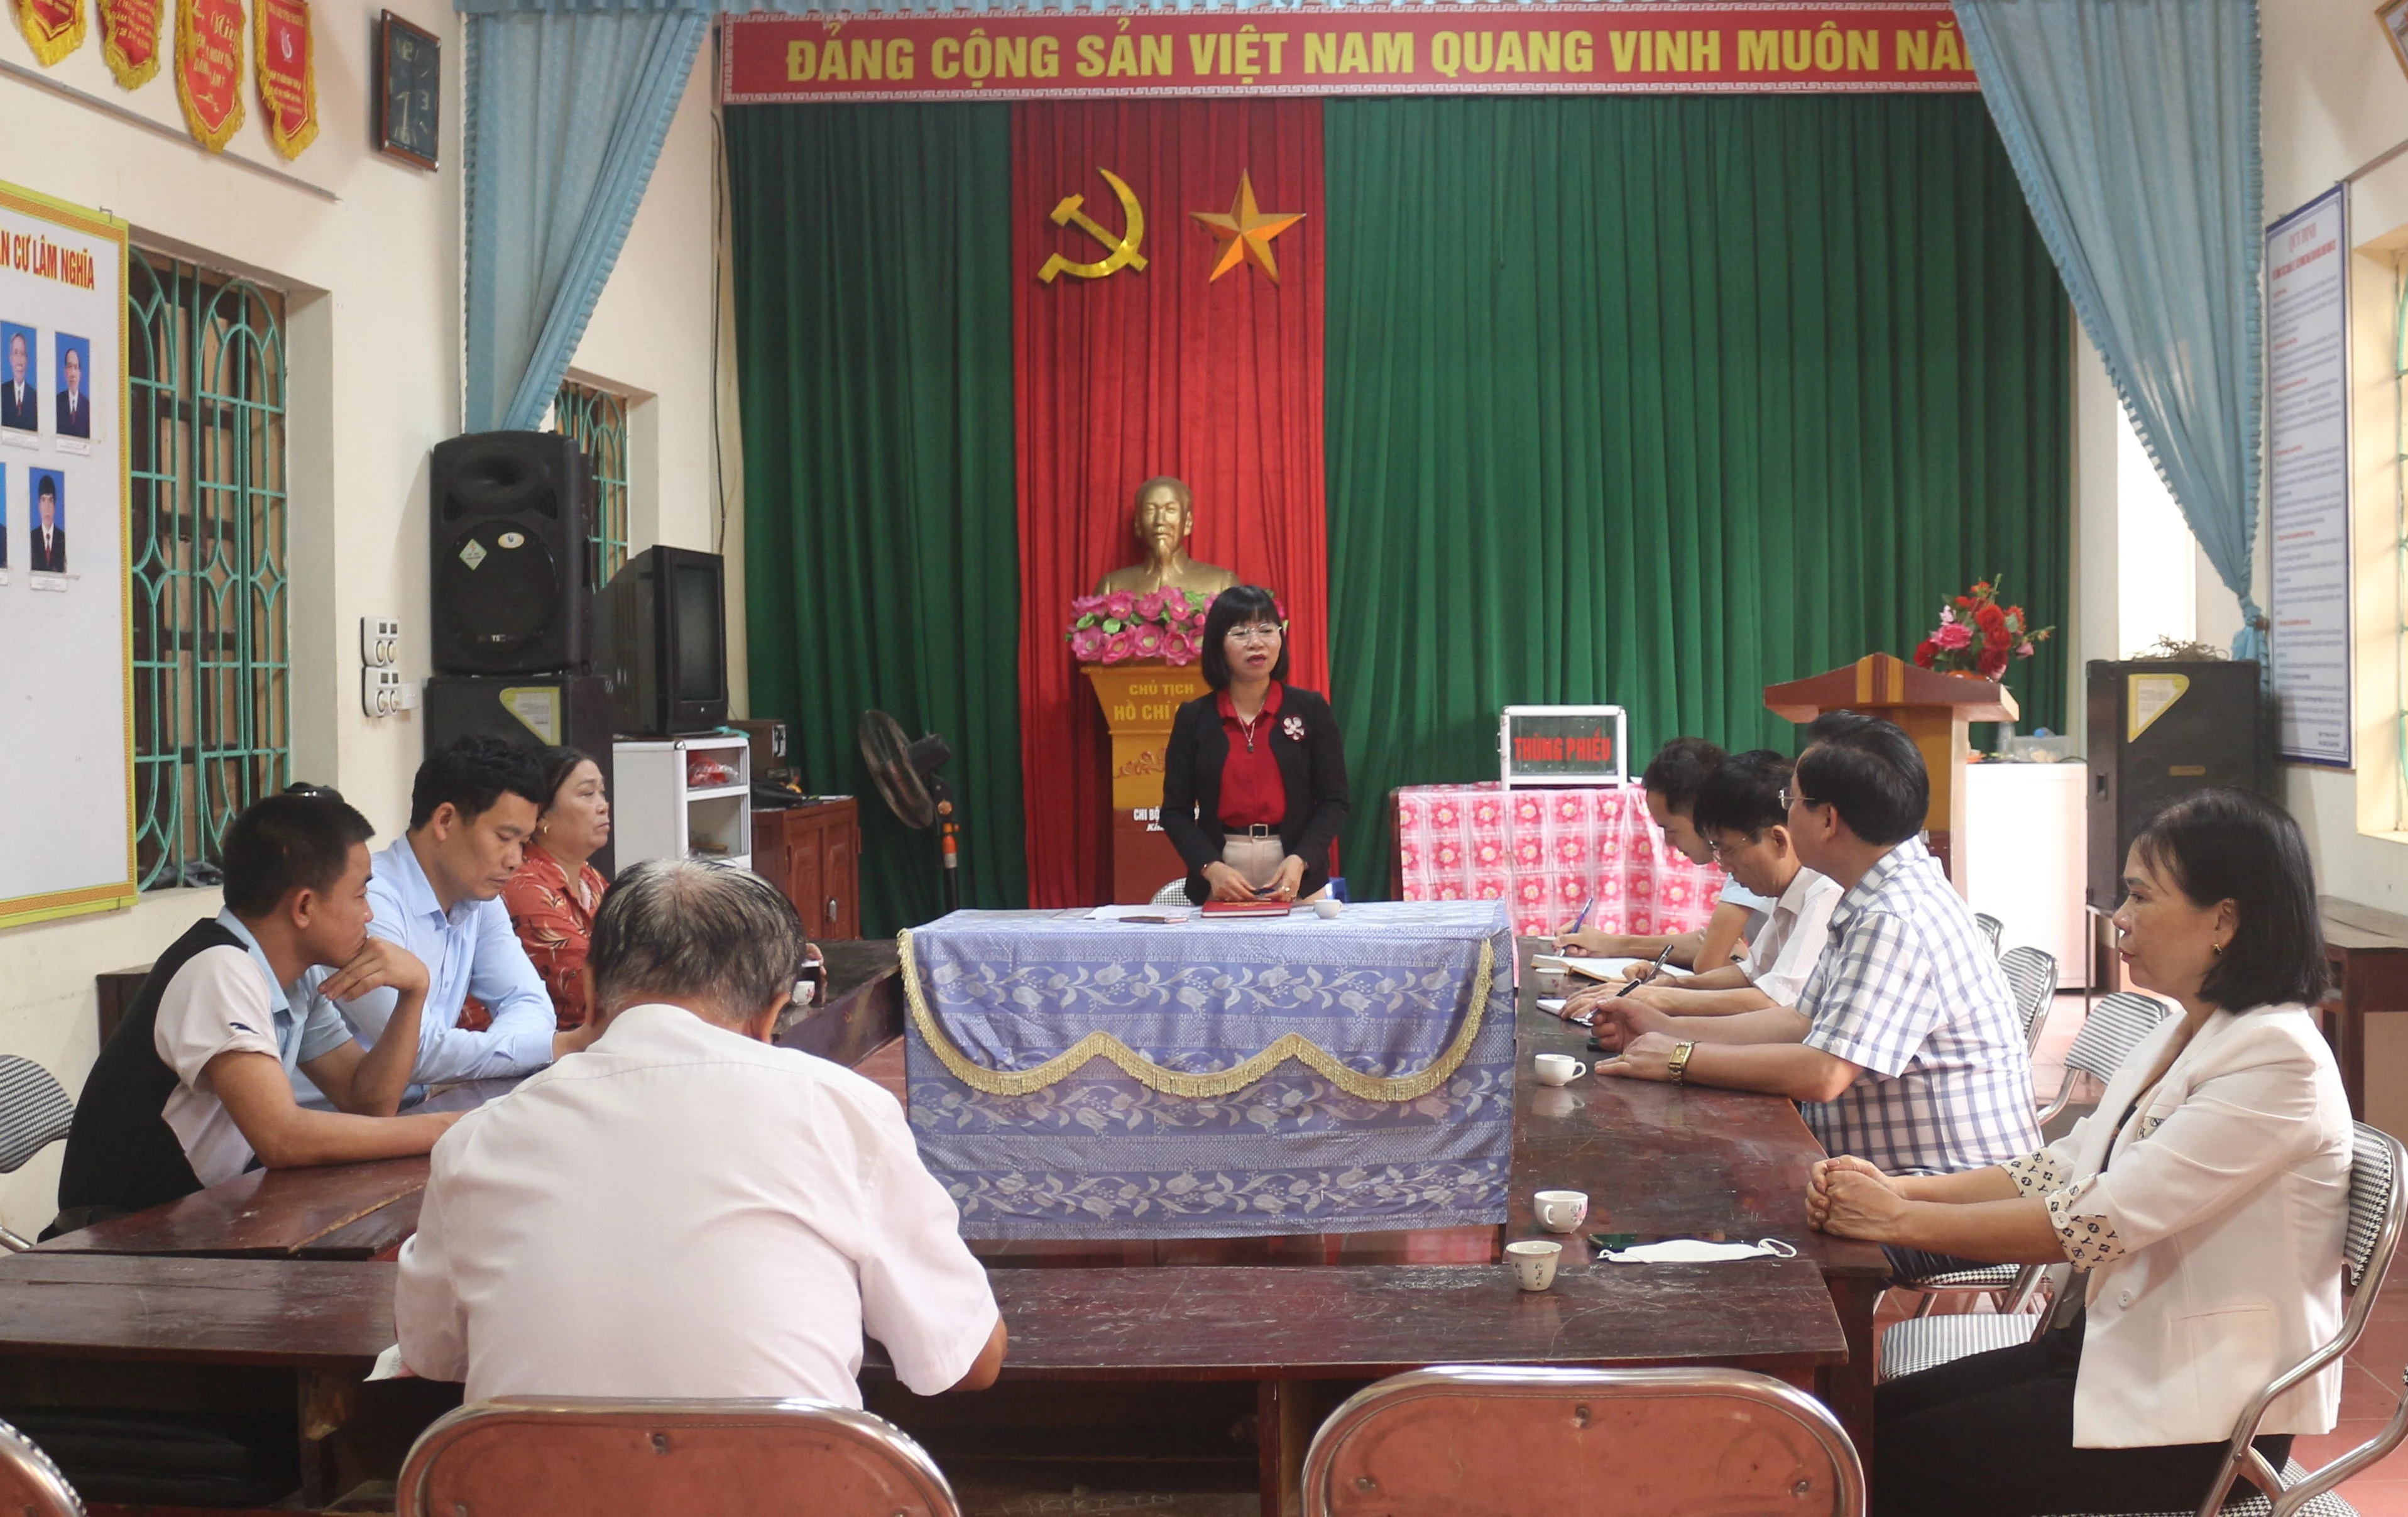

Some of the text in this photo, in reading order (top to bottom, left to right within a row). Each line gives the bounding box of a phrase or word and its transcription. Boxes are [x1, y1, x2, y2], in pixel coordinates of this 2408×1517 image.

[786, 22, 914, 81] ĐẢNG
[931, 29, 1059, 88] CỘNG
[1076, 18, 1173, 77] SẢN
[1188, 24, 1289, 84] VIỆT
[1304, 32, 1415, 74] NAM
[1430, 30, 1594, 78] QUANG
[1609, 30, 1721, 72] VINH
[1738, 21, 1879, 71] MUÔN
[13, 233, 31, 273] CƯ
[33, 233, 57, 280] LÂM
[61, 246, 94, 290] NGHĨA
[1129, 680, 1195, 697] CHỦ TỊCH
[1114, 699, 1136, 721] HỒ
[1141, 700, 1171, 720] CHÍ
[1514, 726, 1611, 762] THÙNG PHIẾU
[1133, 806, 1161, 823] CHI BỘ
